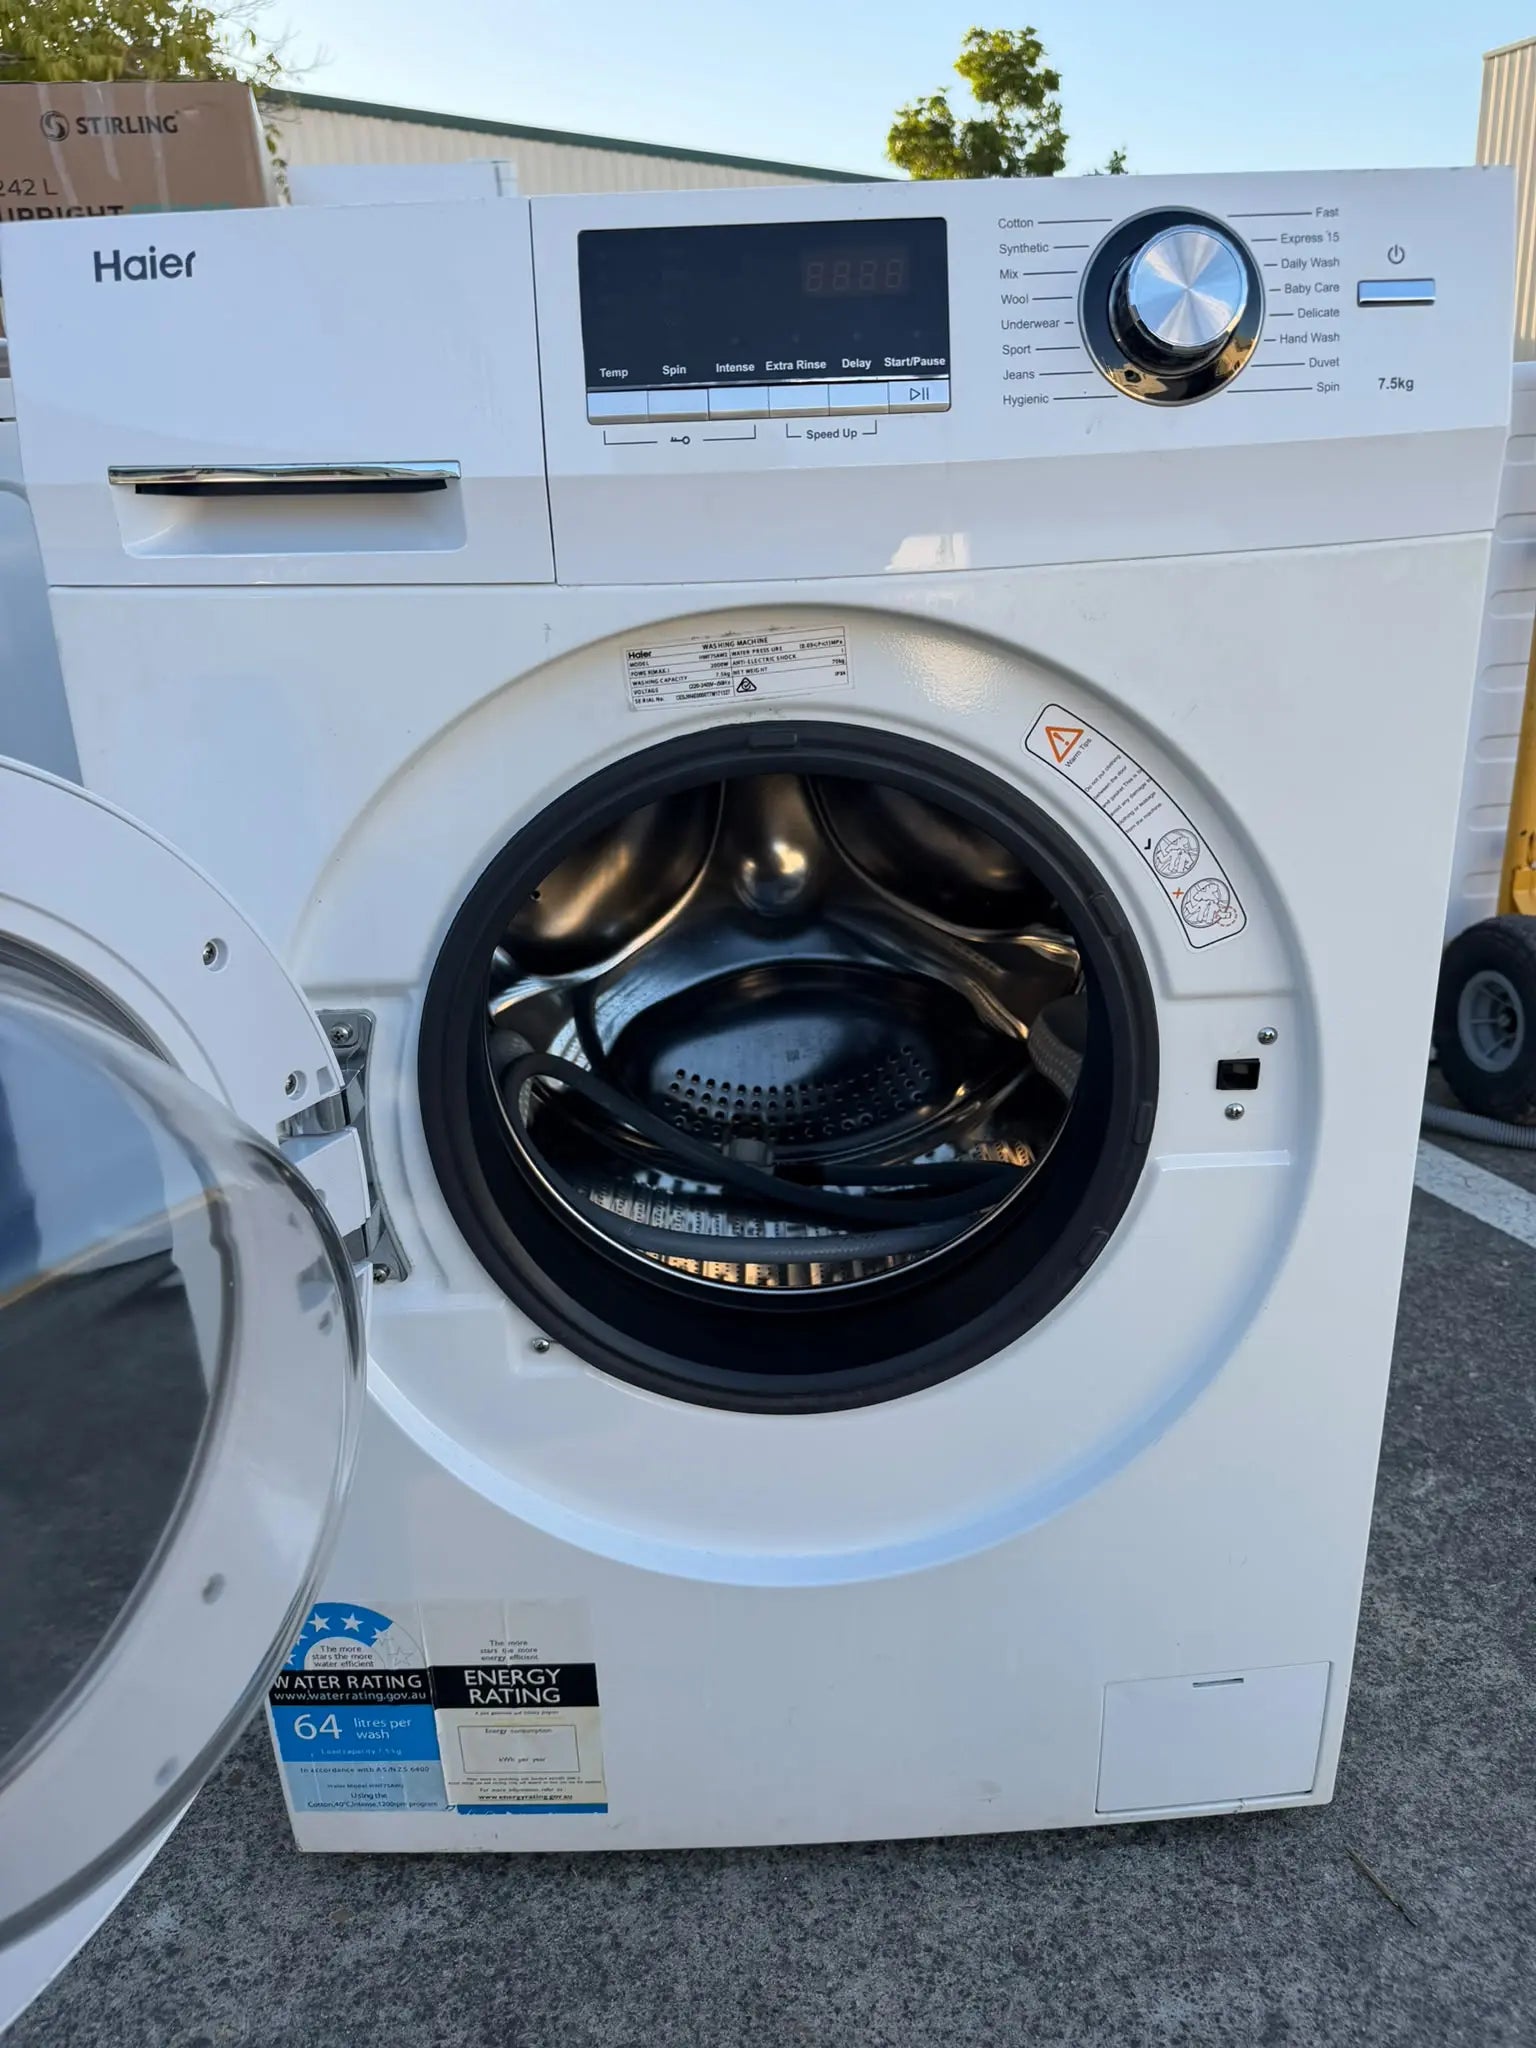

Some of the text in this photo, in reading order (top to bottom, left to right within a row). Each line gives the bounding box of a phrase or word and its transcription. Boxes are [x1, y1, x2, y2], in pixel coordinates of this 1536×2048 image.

[76, 115, 178, 135] STIRLING
[43, 177, 58, 196] L
[1315, 206, 1340, 218] Fast
[998, 217, 1034, 229] Cotton
[1280, 233, 1324, 246] Express
[999, 242, 1049, 254] Synthetic
[93, 246, 196, 282] Haier
[1280, 256, 1340, 271] Daily Wash
[999, 268, 1019, 280] Mix
[1284, 281, 1340, 295] Baby Care
[1000, 293, 1029, 305] Wool
[1297, 306, 1340, 319] Delicate
[1000, 317, 1060, 330] Underwear
[1279, 331, 1340, 344] Hand Wash
[1002, 343, 1032, 357] Sport
[715, 361, 755, 373] Intense
[765, 358, 827, 372] Extra Rinse
[841, 357, 872, 371] Delay
[884, 355, 946, 368] Start/Pause
[1308, 356, 1340, 368] Duvet
[599, 367, 630, 379] Temp
[662, 364, 687, 377] Spin
[1002, 368, 1035, 381] Jeans
[1316, 381, 1340, 394] Spin
[1377, 377, 1415, 392] 7.5kg
[1003, 393, 1049, 407] Hygienic
[806, 427, 858, 441] Speed Up
[702, 636, 768, 650] WASHING MACHINE
[628, 650, 652, 660] Haier
[632, 677, 660, 687] WASHING
[1065, 738, 1092, 767] Warm Tips
[321, 1645, 362, 1653] The more
[489, 1639, 505, 1647] The
[334, 1652, 349, 1660] the
[340, 1660, 375, 1668] efficient
[274, 1674, 422, 1689] WATER RATING
[464, 1668, 561, 1686] ENERGY
[273, 1690, 427, 1702] www.waterrating.gov.au
[469, 1687, 561, 1704] RATING
[294, 1713, 343, 1740] 64
[353, 1717, 412, 1730] litres per
[356, 1729, 390, 1740] wash
[350, 1793, 374, 1801] Using
